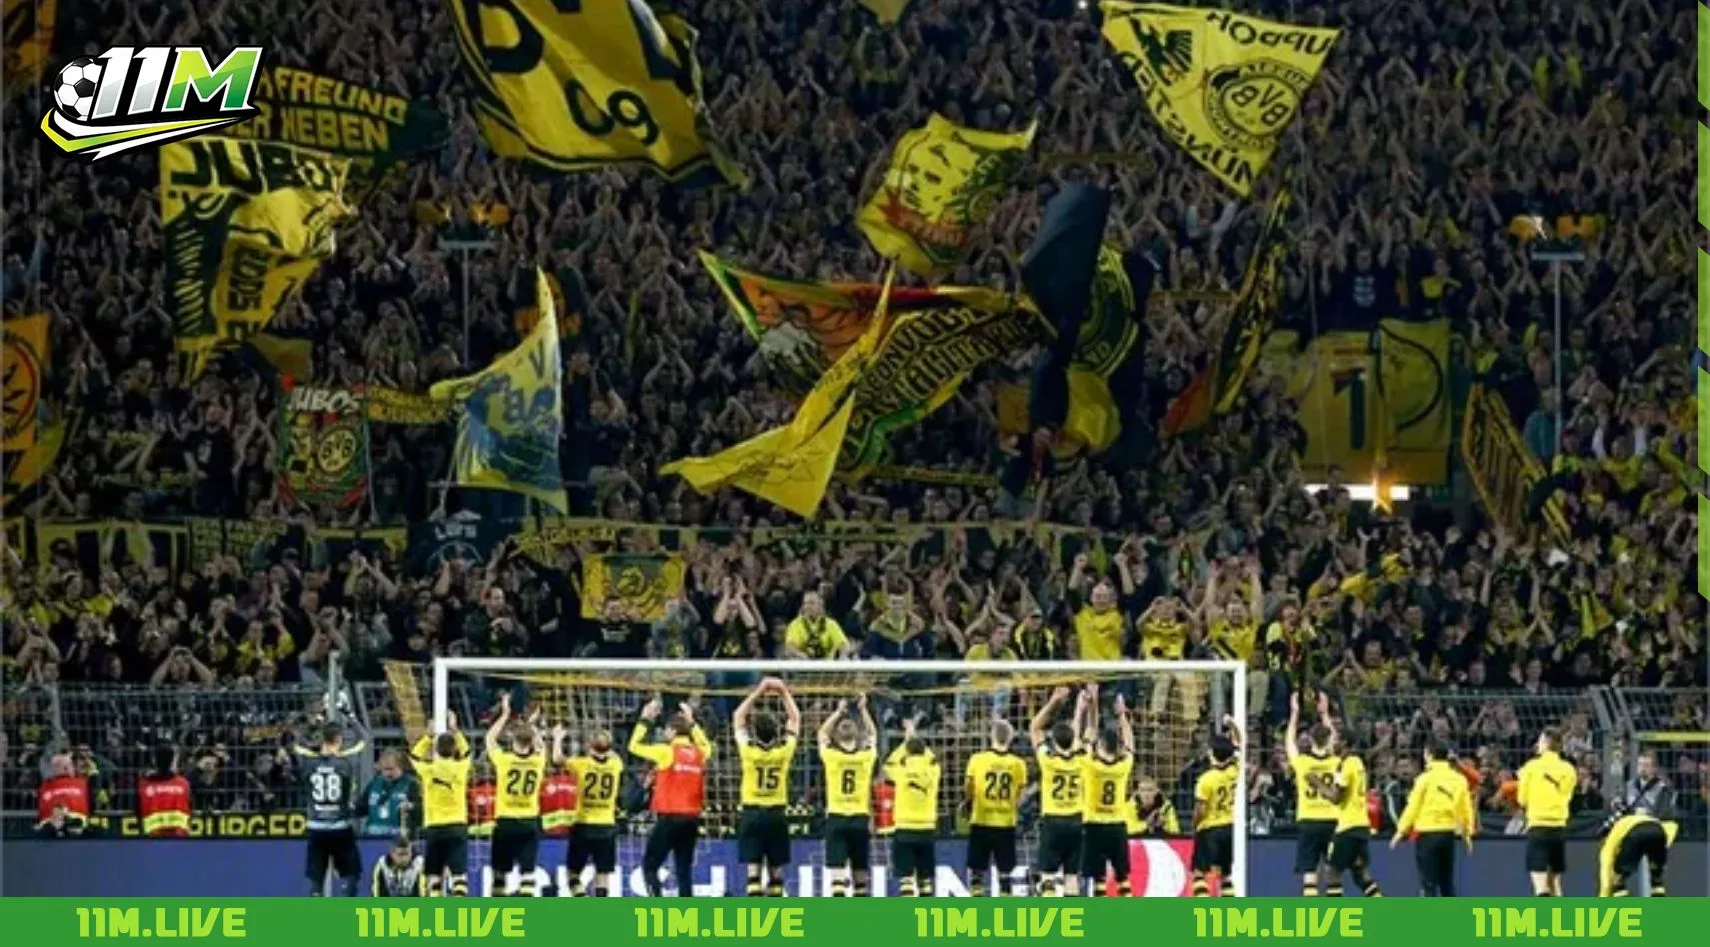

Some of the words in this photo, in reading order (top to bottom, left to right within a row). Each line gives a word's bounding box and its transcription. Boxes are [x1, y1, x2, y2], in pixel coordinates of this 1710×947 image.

[310, 773, 342, 802] 38
[506, 769, 538, 796] 26
[584, 772, 615, 800] 29
[755, 766, 781, 790] 15
[841, 769, 856, 795] 6
[985, 771, 1012, 800] 28
[1051, 774, 1081, 800] 25
[1102, 780, 1116, 805] 8
